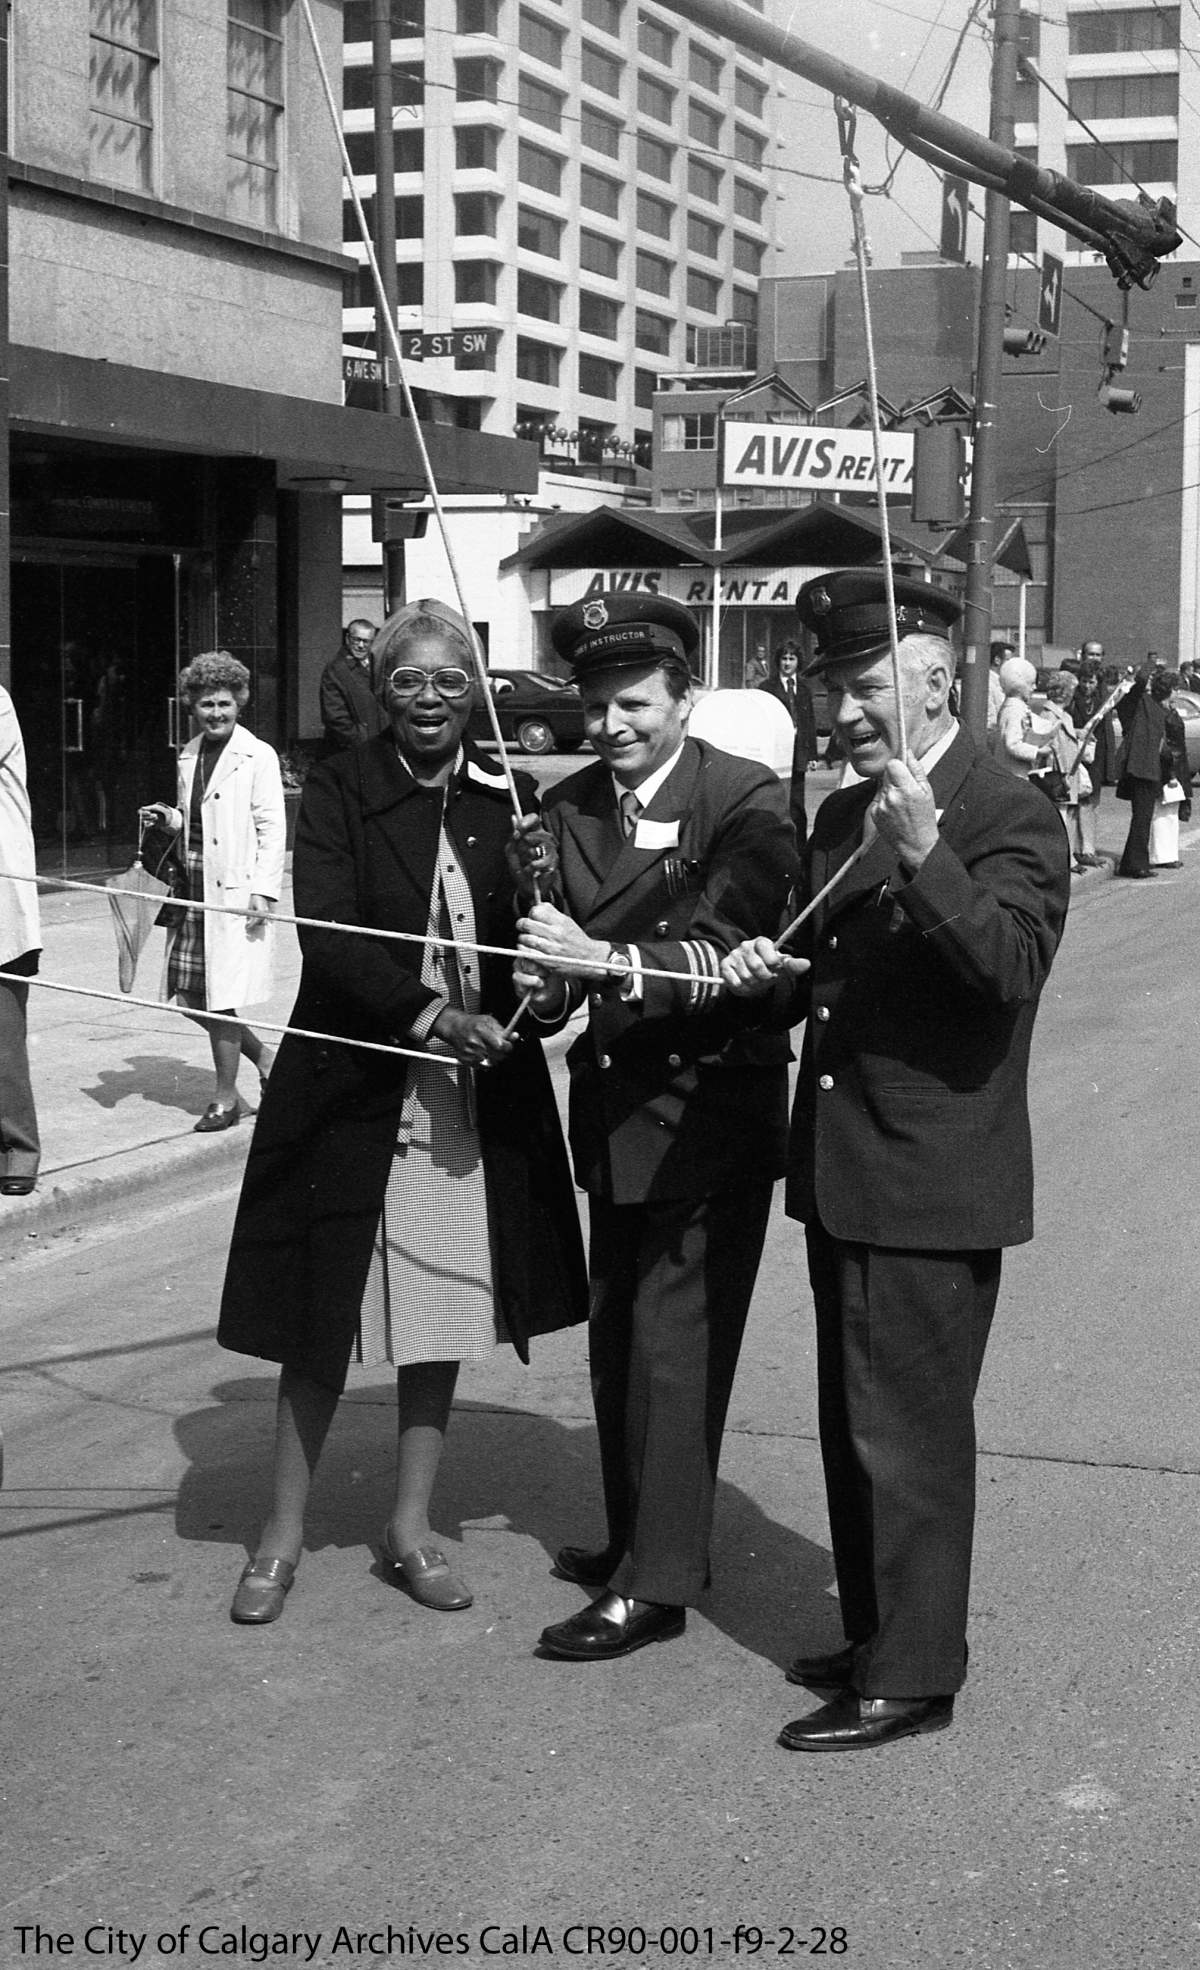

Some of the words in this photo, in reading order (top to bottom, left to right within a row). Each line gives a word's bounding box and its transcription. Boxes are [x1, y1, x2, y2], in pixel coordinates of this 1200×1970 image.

[410, 337, 422, 355] 2
[431, 336, 454, 354] ST
[462, 334, 487, 353] SW
[346, 359, 353, 377] 6
[353, 360, 369, 379] AVE
[370, 362, 382, 381] SW
[735, 435, 836, 478] AVIS
[583, 572, 662, 597] AVIS
[771, 581, 788, 601] A
[589, 631, 645, 649] INSTRUCTOR
